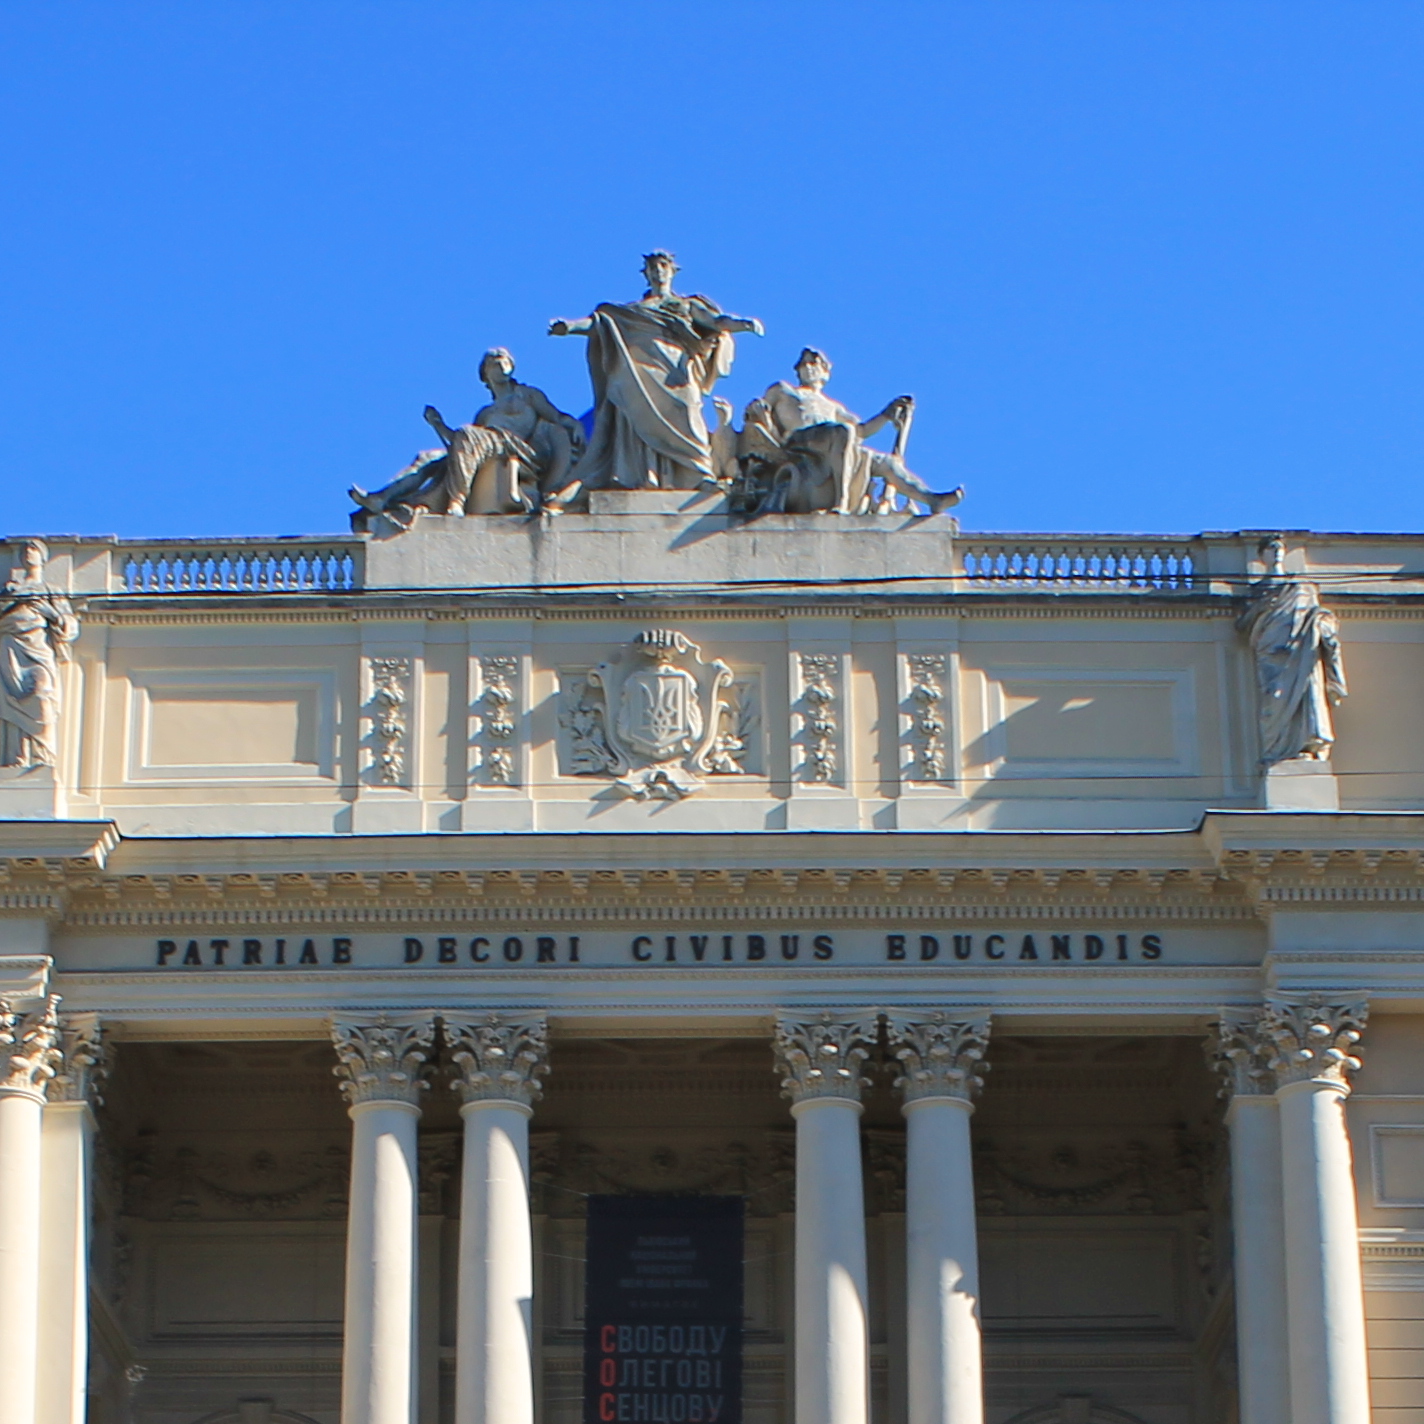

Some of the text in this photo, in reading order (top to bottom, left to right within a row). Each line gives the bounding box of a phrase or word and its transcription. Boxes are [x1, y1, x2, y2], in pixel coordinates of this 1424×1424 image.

[156, 934, 1164, 966] PATRIAE DECORI CIVIBUS EDUCANDIS
[601, 1325, 727, 1356] СВОБОДУ
[600, 1358, 721, 1388] ОЛЕГОВІ
[600, 1392, 723, 1424] СЕНЦОВУ
